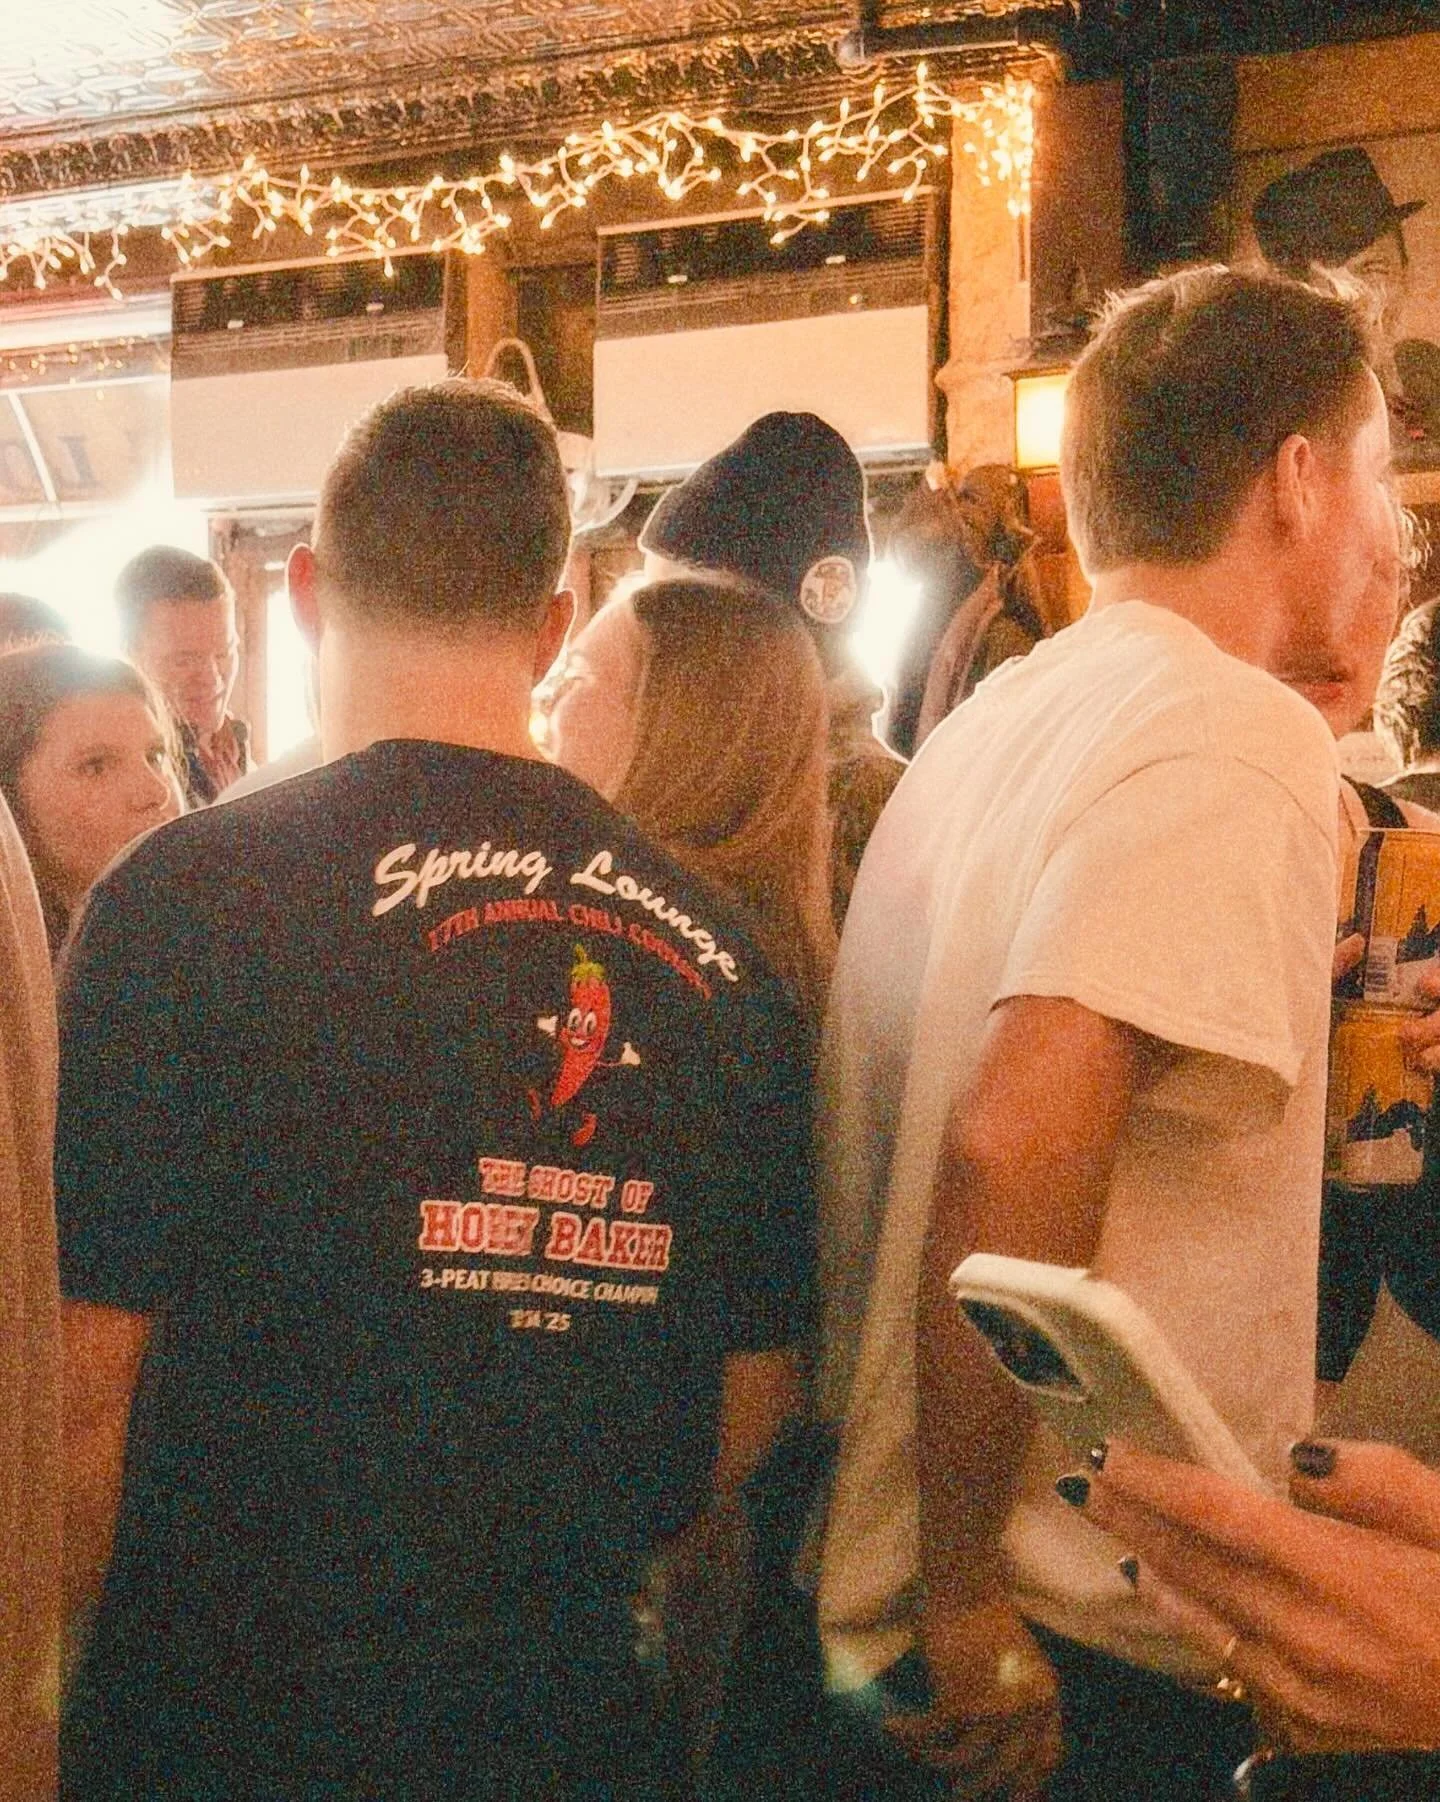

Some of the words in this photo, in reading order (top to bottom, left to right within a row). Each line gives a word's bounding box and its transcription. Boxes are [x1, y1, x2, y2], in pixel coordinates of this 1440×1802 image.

[372, 841, 553, 917] Spring
[570, 850, 739, 982] Lounge
[620, 1179, 655, 1214] OF
[544, 1211, 673, 1271] BAKER
[420, 1268, 492, 1291] 3-PEAT
